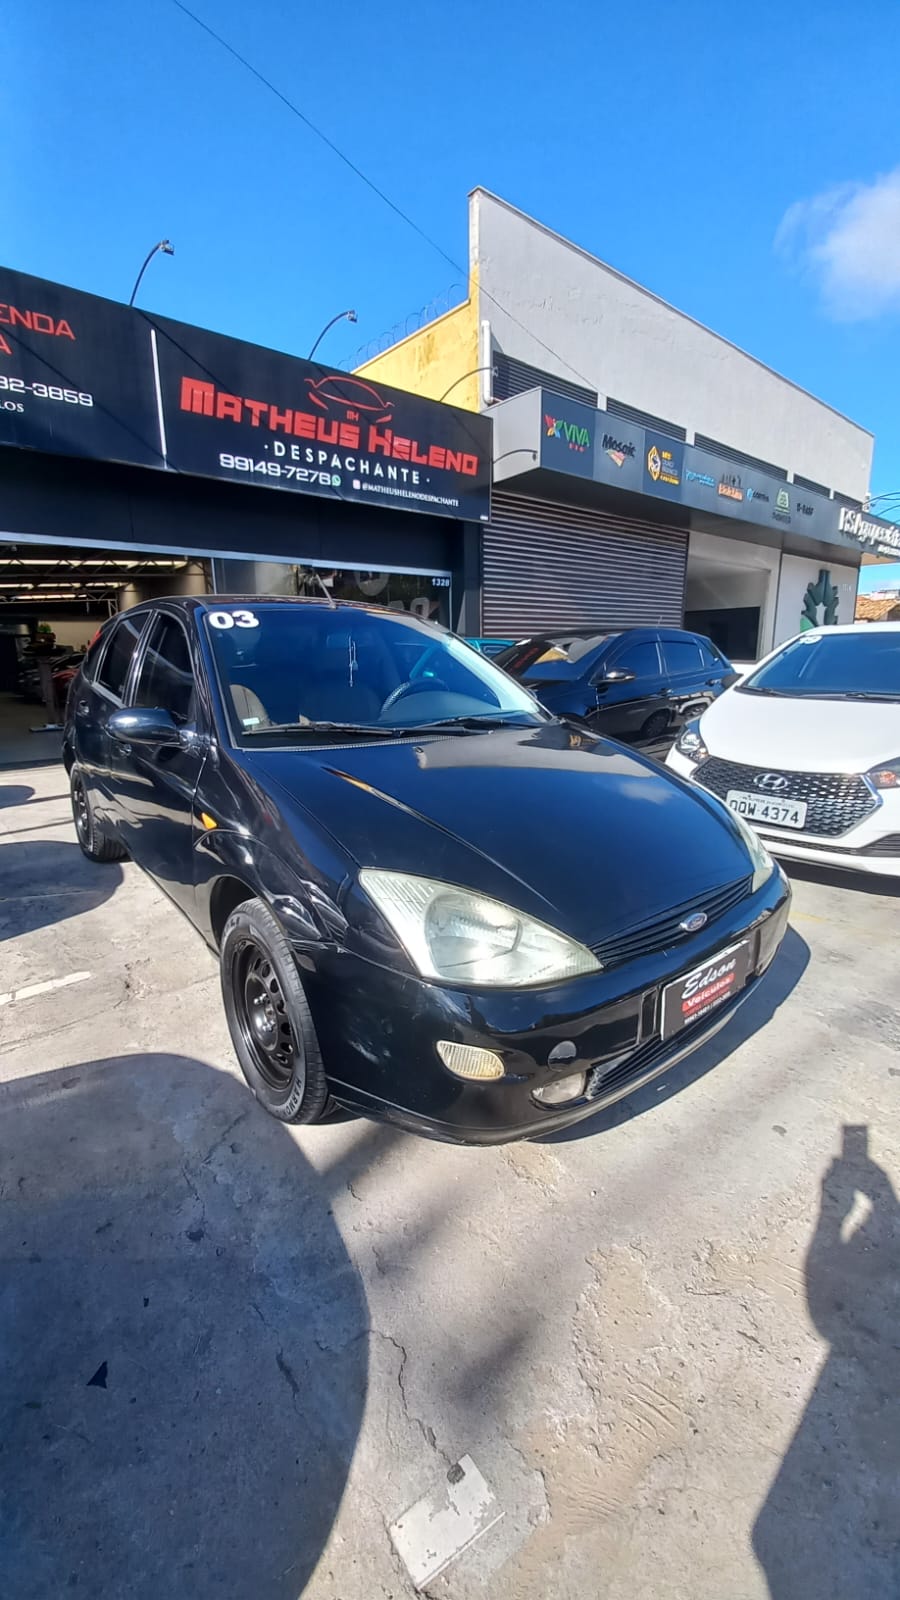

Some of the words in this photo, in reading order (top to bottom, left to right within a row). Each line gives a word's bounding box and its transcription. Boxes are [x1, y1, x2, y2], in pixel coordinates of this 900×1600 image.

[273, 441, 420, 485] DESPACHANTE
[208, 609, 260, 629] 03
[681, 958, 737, 1000] Edson
